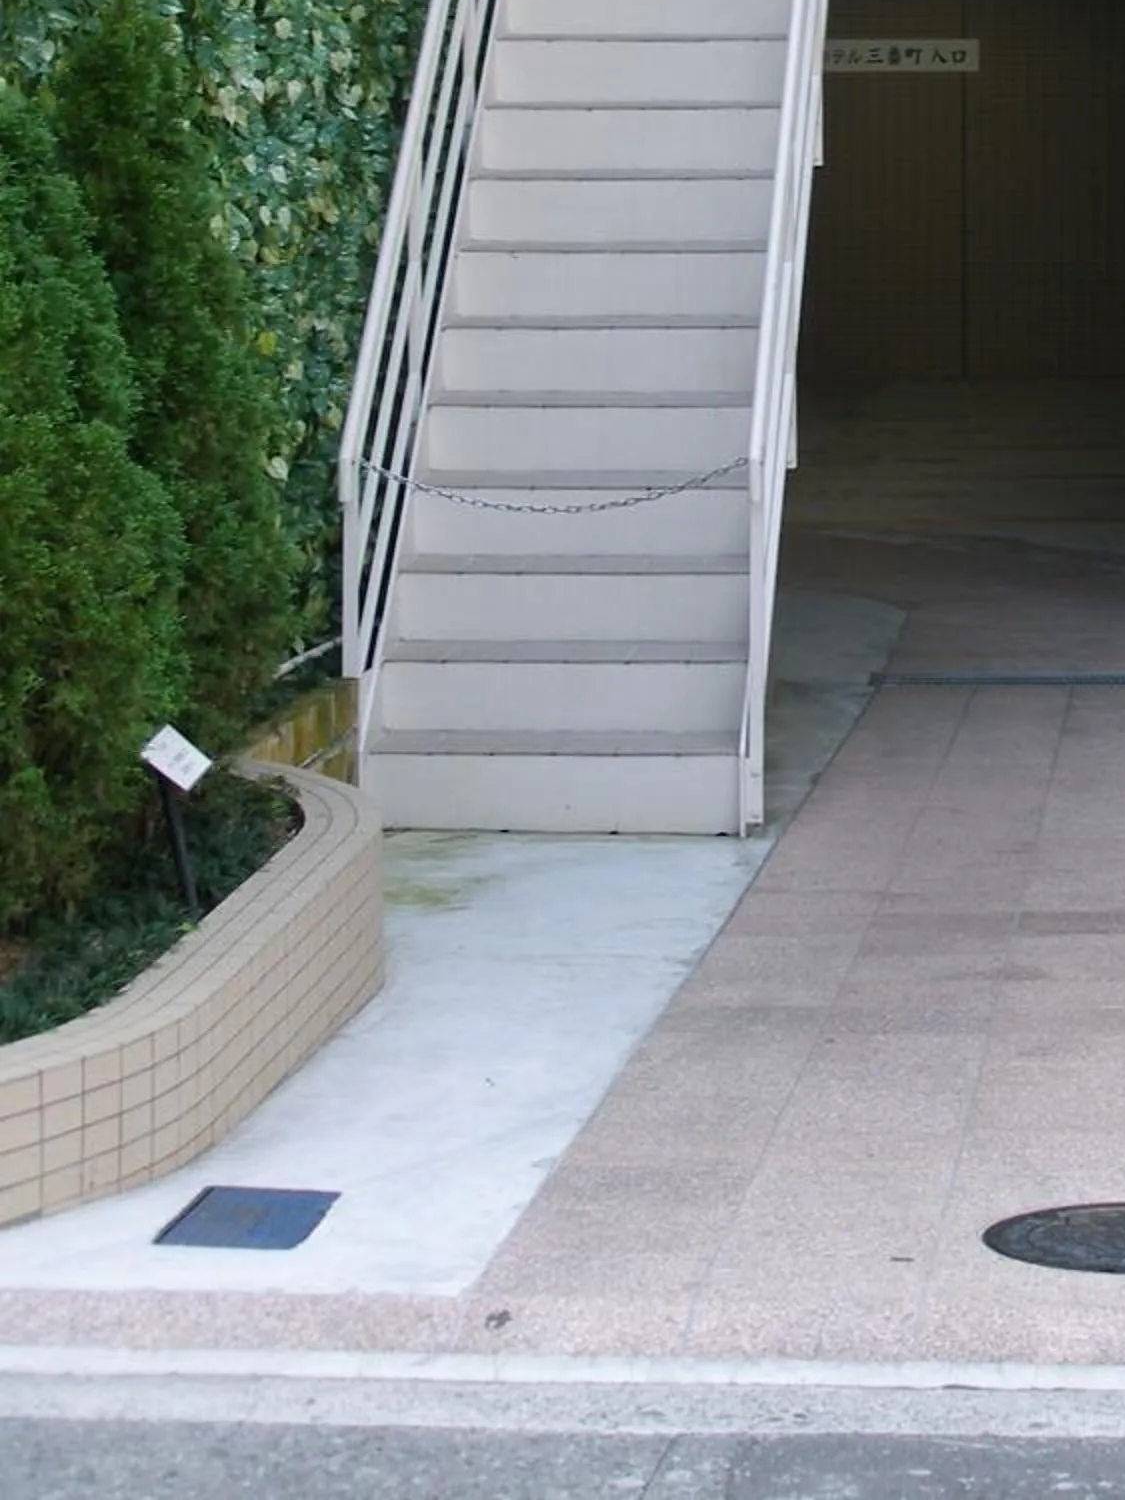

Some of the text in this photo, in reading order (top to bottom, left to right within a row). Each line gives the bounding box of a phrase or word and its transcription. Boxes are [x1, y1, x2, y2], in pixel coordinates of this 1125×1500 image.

[825, 46, 967, 65] テル三番町入口
